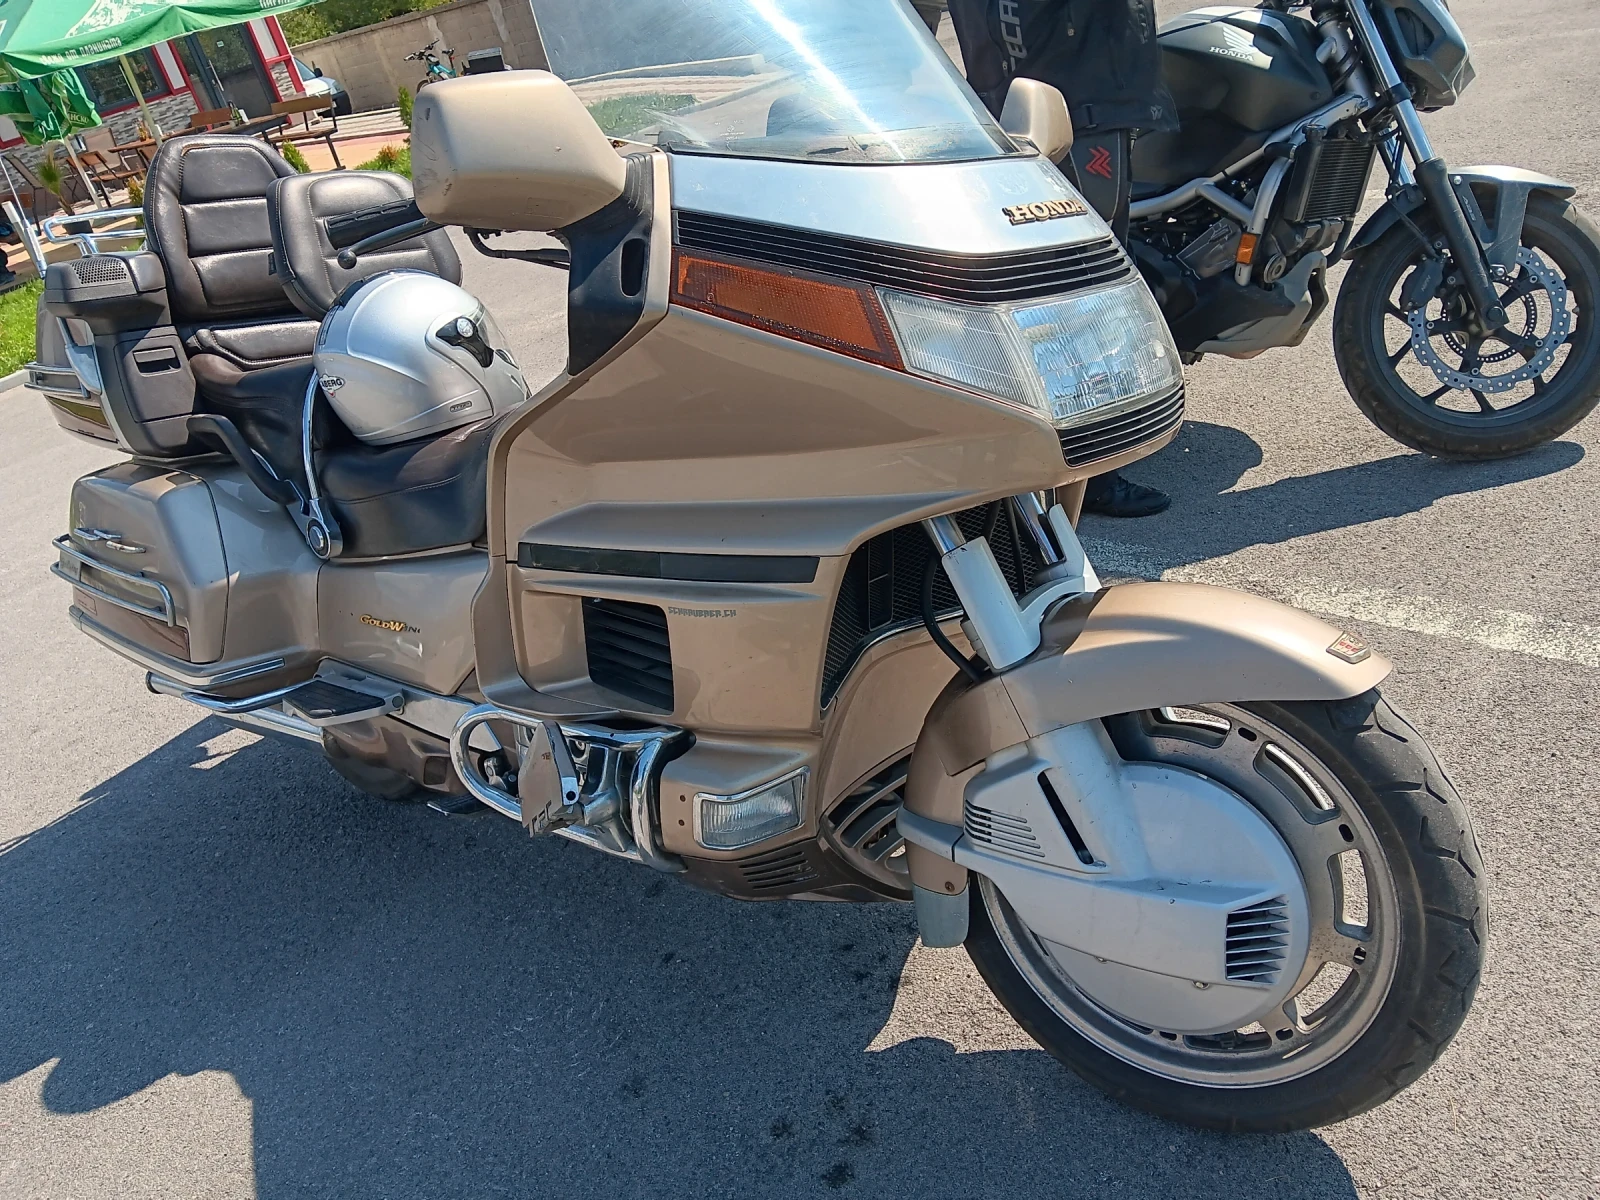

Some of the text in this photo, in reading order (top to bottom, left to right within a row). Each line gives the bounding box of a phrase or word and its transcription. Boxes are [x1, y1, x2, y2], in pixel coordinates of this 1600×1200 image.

[999, 0, 1027, 72] ECA
[1209, 46, 1254, 62] HONDA
[1002, 200, 1088, 226] HONDA
[320, 378, 343, 388] ABERG
